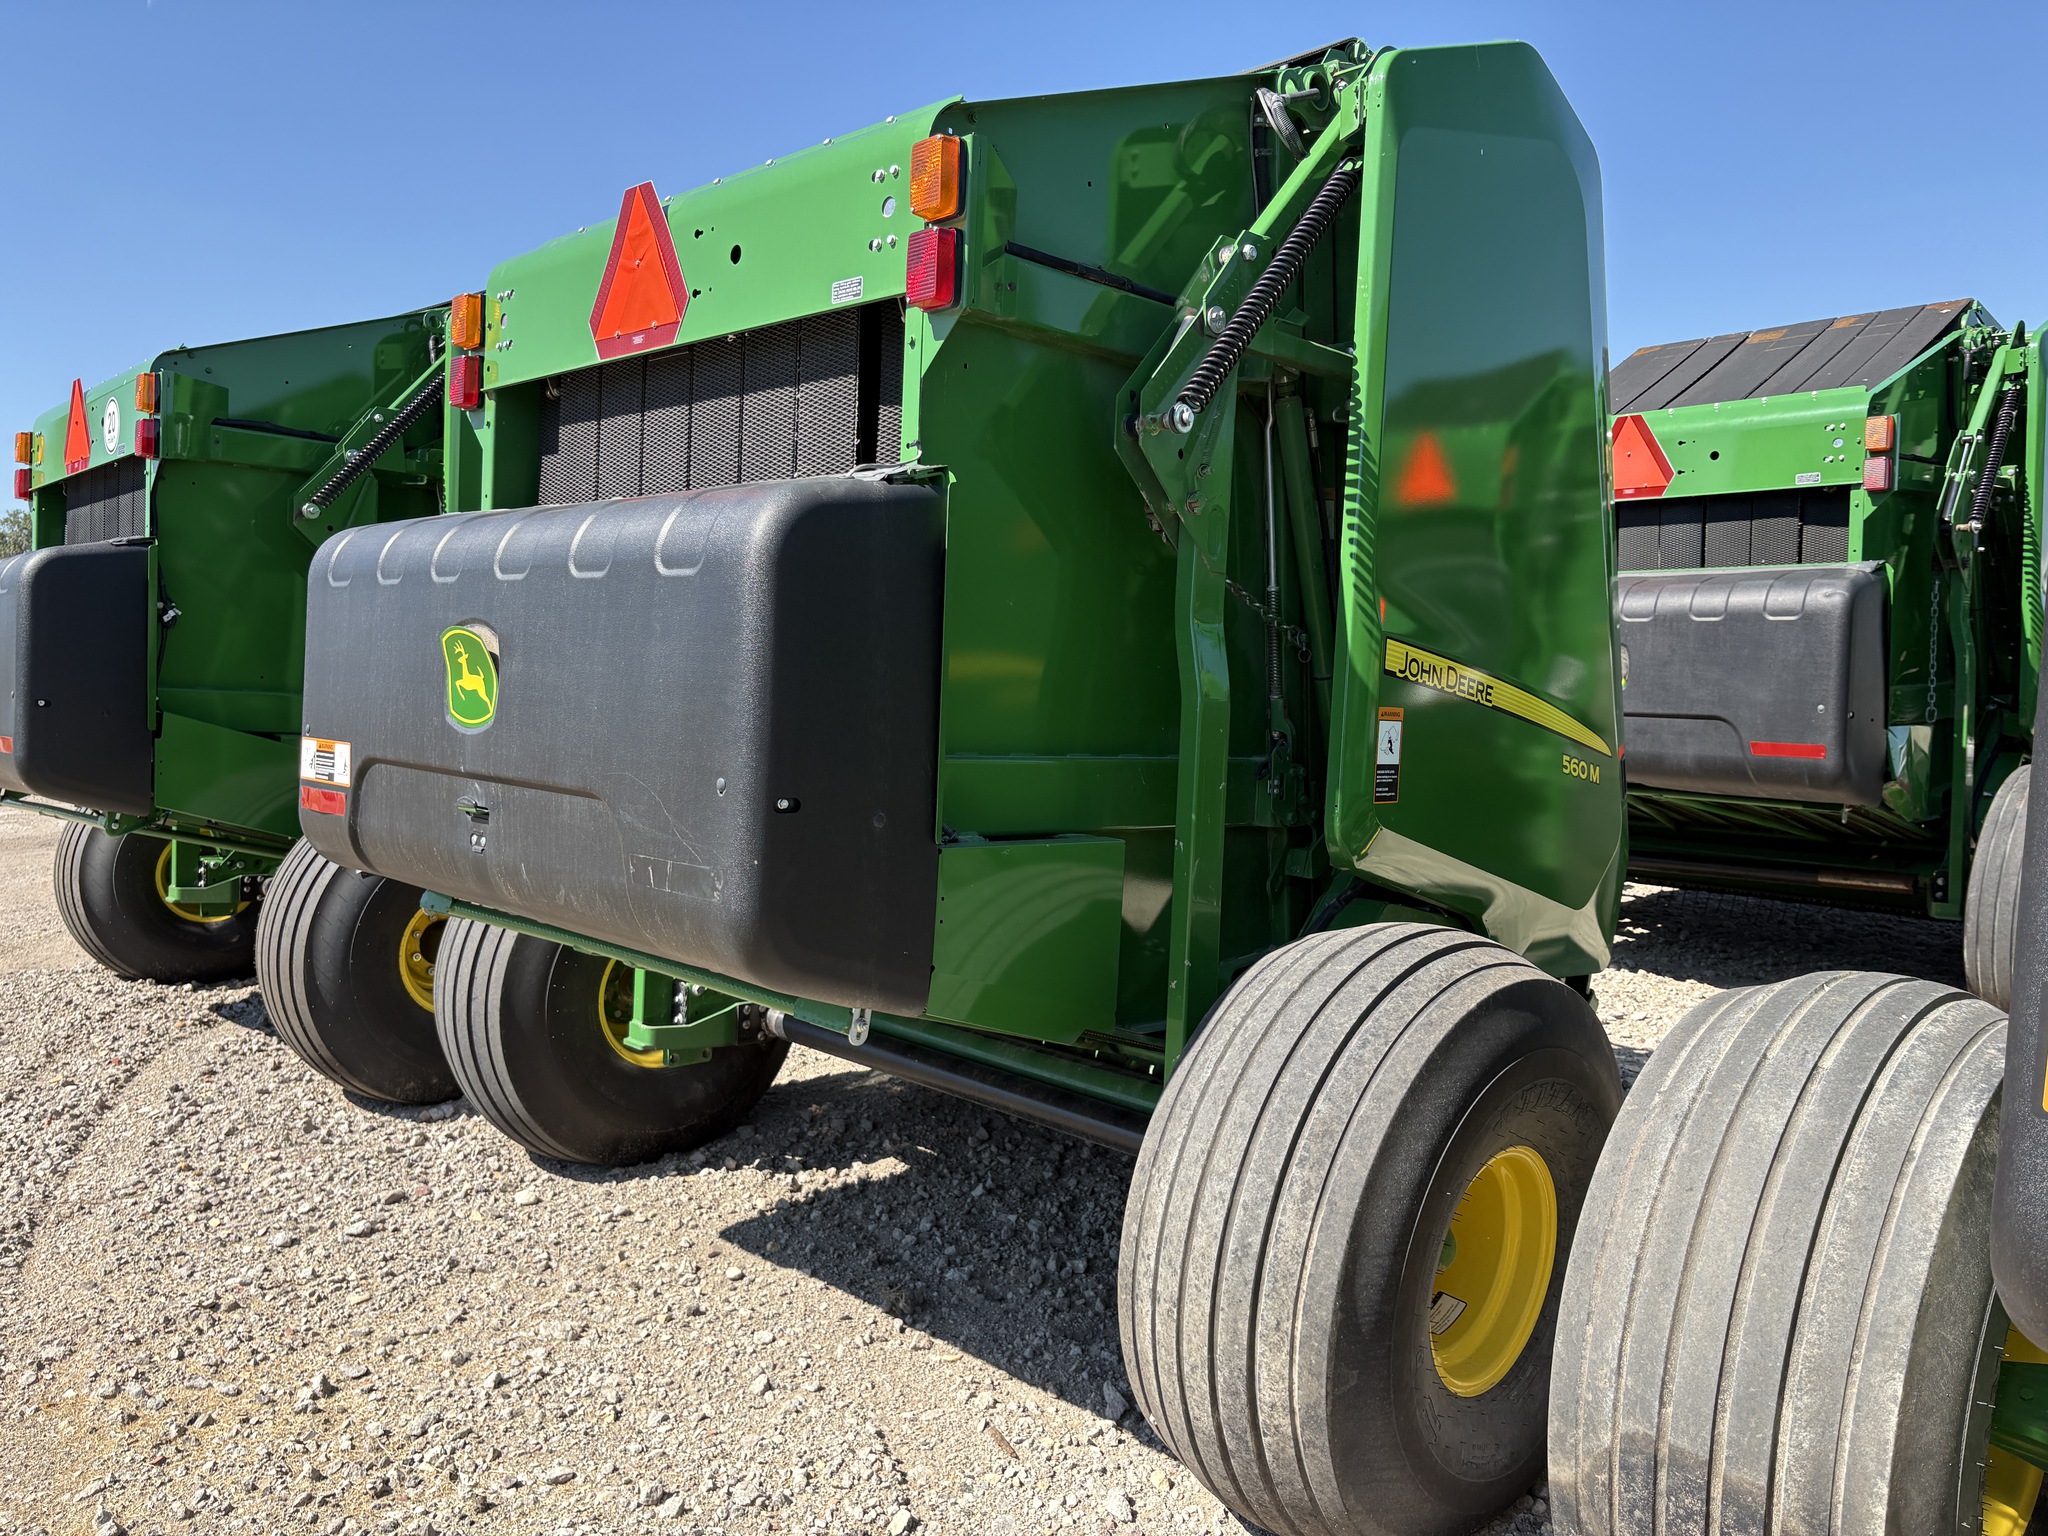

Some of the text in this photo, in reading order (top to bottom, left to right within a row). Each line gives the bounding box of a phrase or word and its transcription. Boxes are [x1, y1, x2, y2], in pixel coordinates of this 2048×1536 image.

[108, 411, 116, 434] 20
[1398, 651, 1494, 704] JOHN DEERE
[1562, 753, 1600, 785] 560 M
